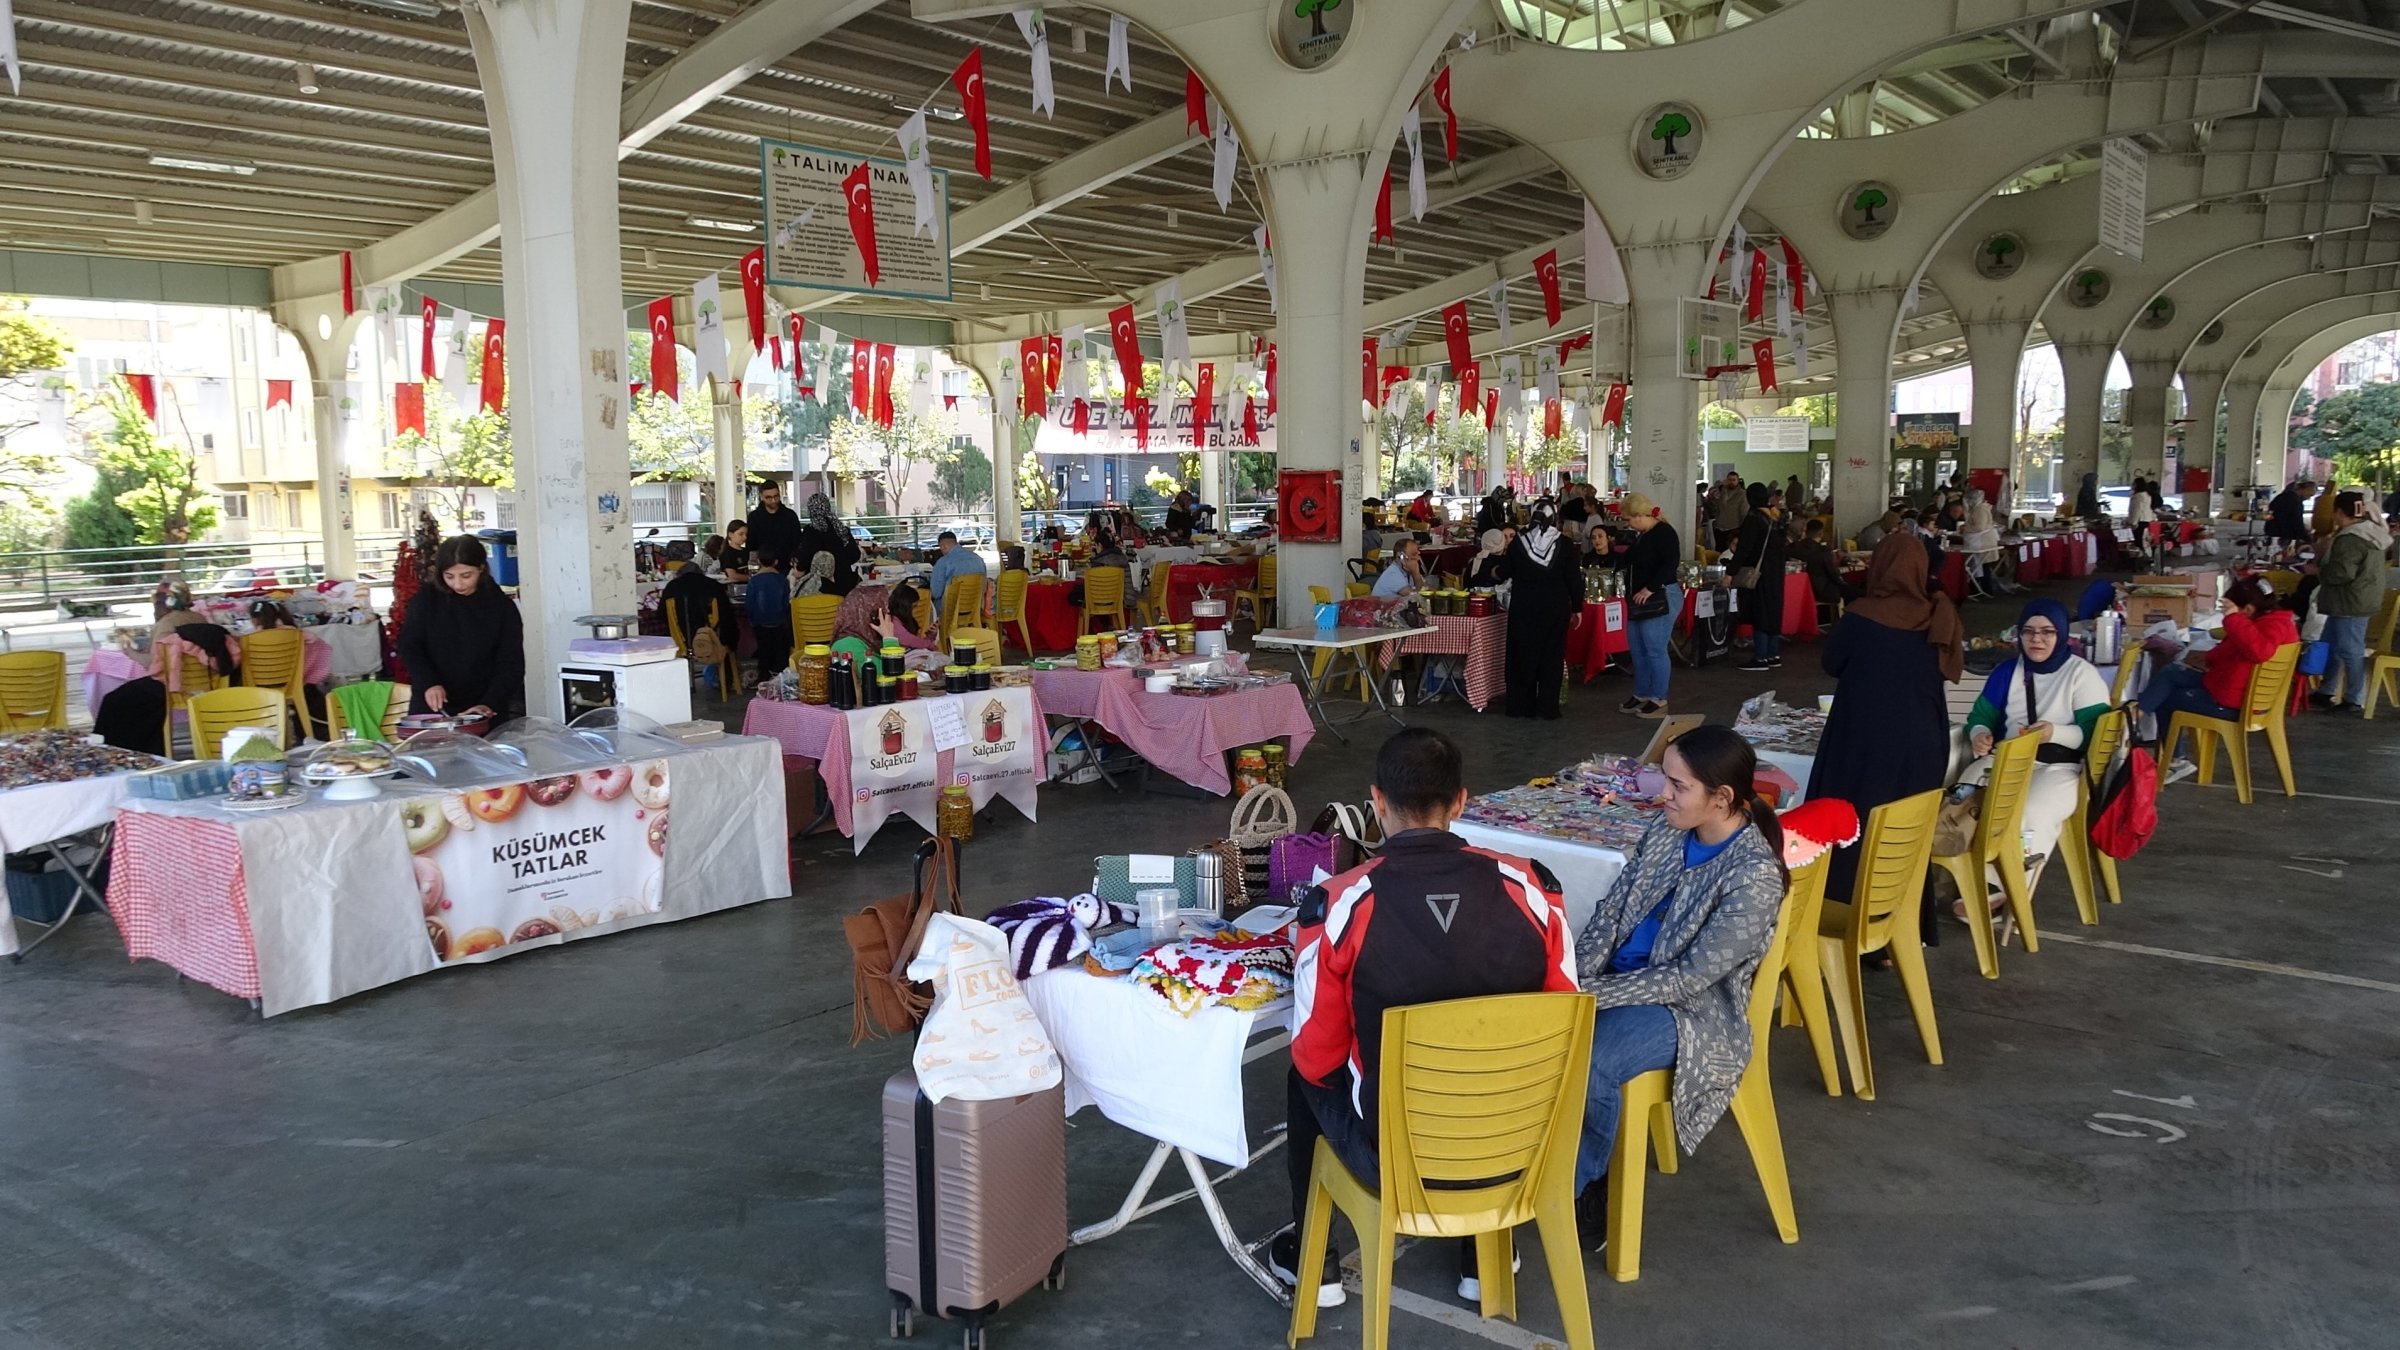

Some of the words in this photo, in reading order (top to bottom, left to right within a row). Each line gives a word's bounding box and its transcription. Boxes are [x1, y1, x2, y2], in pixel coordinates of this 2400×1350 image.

[972, 741, 1016, 758] SalçaEvi27
[870, 752, 917, 771] SalçaEvi27
[971, 766, 1033, 783] Salcaevi.27.official
[871, 779, 935, 798] Salcaevi.27.official
[493, 825, 606, 863] KÜSÜMCEK
[512, 849, 588, 879] TATLAR
[963, 966, 1015, 998] FLO
